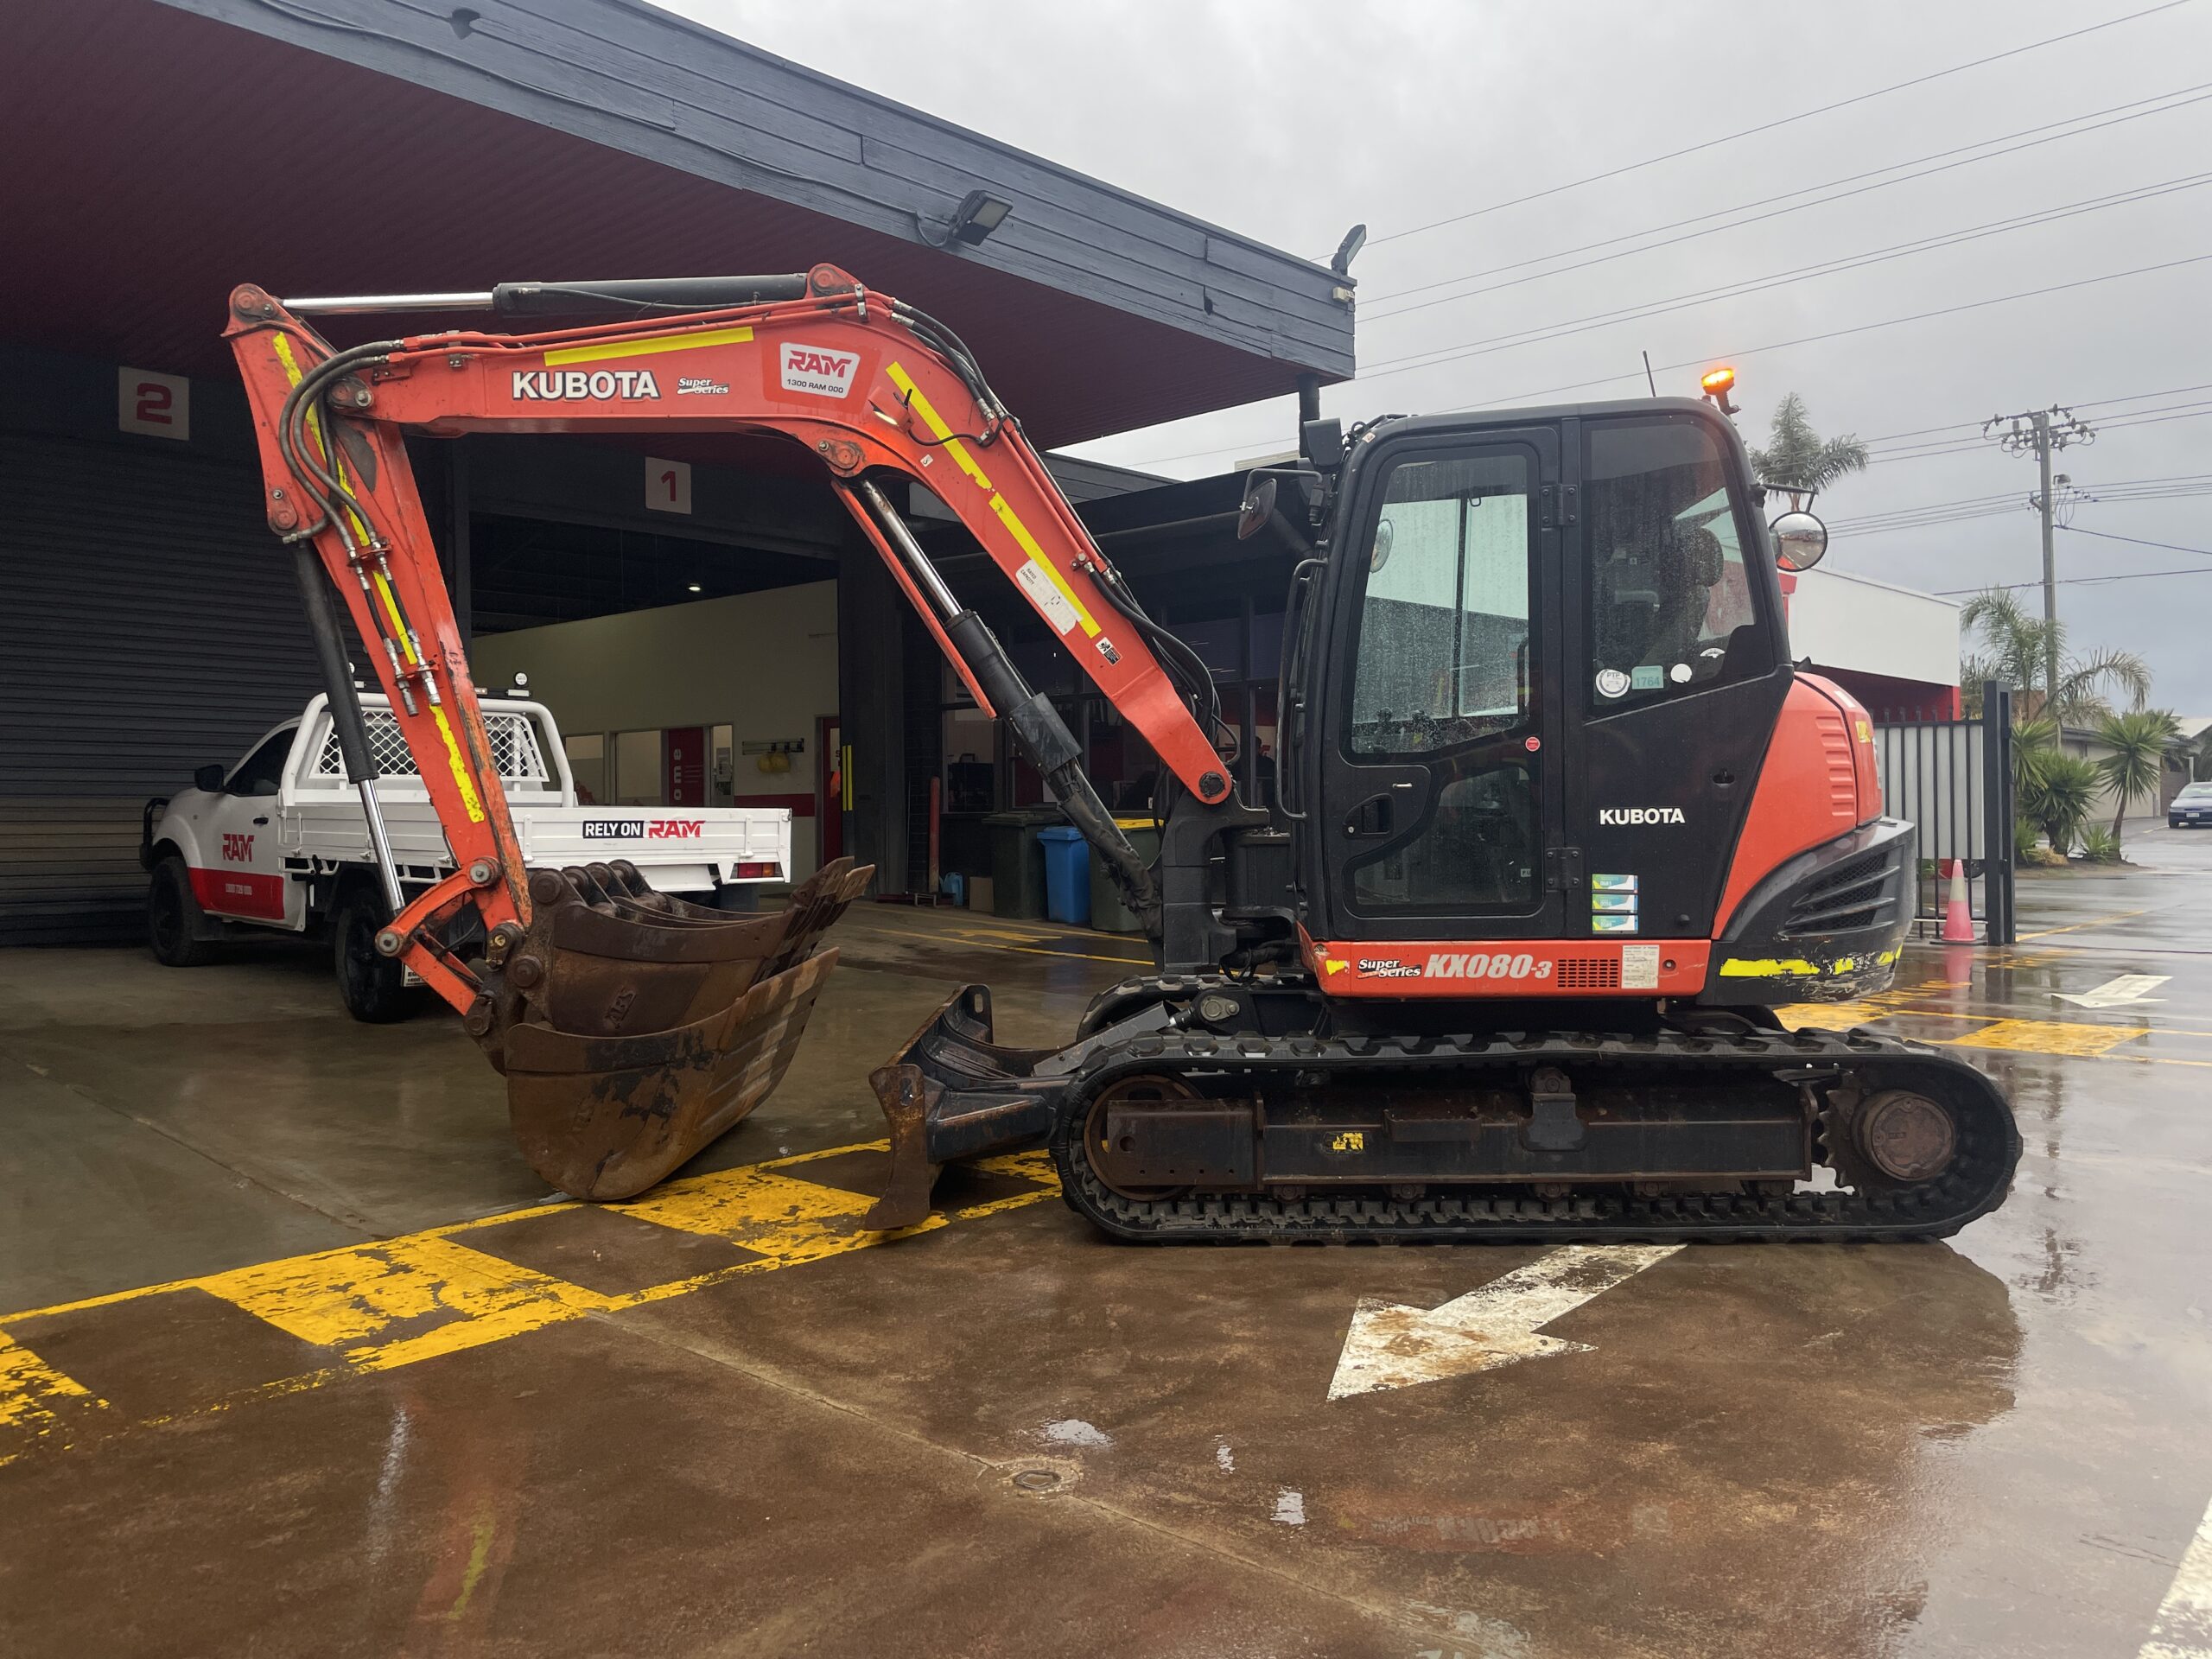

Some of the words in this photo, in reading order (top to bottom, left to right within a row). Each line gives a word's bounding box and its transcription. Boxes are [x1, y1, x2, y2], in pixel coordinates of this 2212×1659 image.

[788, 350, 852, 378] RAM
[512, 370, 660, 400] KUBOTA
[678, 378, 712, 388] Super
[694, 385, 729, 394] Series
[786, 378, 807, 388] 1300
[808, 382, 827, 391] RAM
[828, 385, 844, 394] 000
[137, 382, 173, 425] 2
[660, 470, 677, 502] 1
[1636, 677, 1661, 687] 1764
[1599, 808, 1686, 825] KUBOTA
[585, 823, 619, 836] RELY
[620, 823, 641, 836] ON
[648, 820, 706, 838] RAM
[222, 833, 255, 862] RAM
[1358, 959, 1400, 971] Super
[1378, 967, 1421, 977] Series
[1424, 954, 1553, 979] KX080-3
